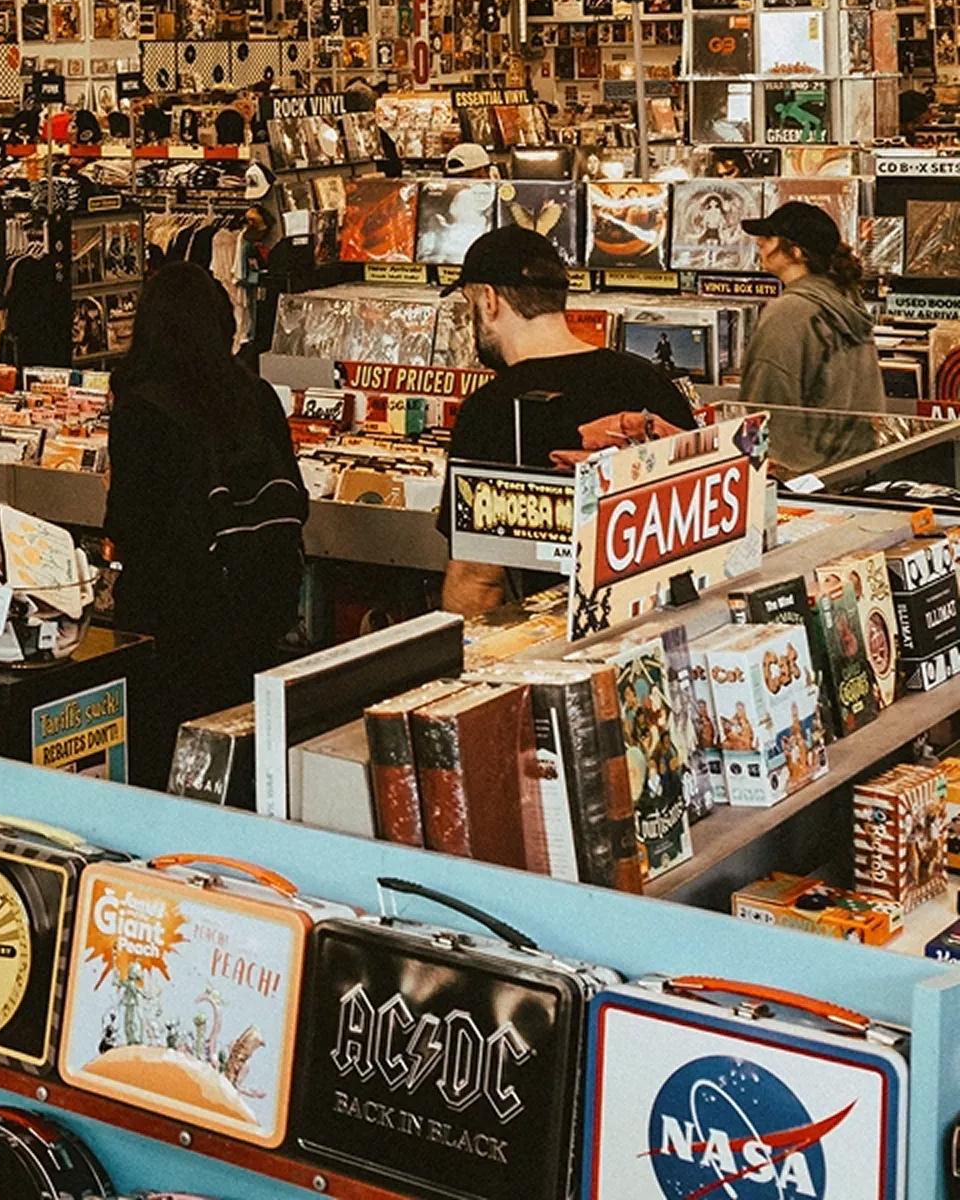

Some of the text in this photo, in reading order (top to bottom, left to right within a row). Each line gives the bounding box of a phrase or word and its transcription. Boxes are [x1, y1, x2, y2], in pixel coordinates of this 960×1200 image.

[273, 95, 347, 118] ROCK VINYL
[456, 89, 530, 107] ESSENTIAL VINYL
[878, 162, 898, 174] CD
[704, 282, 732, 294] VINYL
[733, 283, 753, 294] BOX
[895, 298, 927, 308] USED
[349, 365, 393, 389] JUST
[395, 368, 455, 395] PRICED
[496, 479, 526, 491] PEACE
[472, 481, 554, 531] AMOEBA
[605, 467, 740, 572] GAMES
[42, 732, 87, 765] REBATES
[93, 893, 165, 946] Giant
[117, 935, 160, 959] Peach
[209, 947, 282, 998] PEACH!
[333, 1090, 510, 1164] BACK IN BLACK
[659, 1114, 817, 1198] NASA
